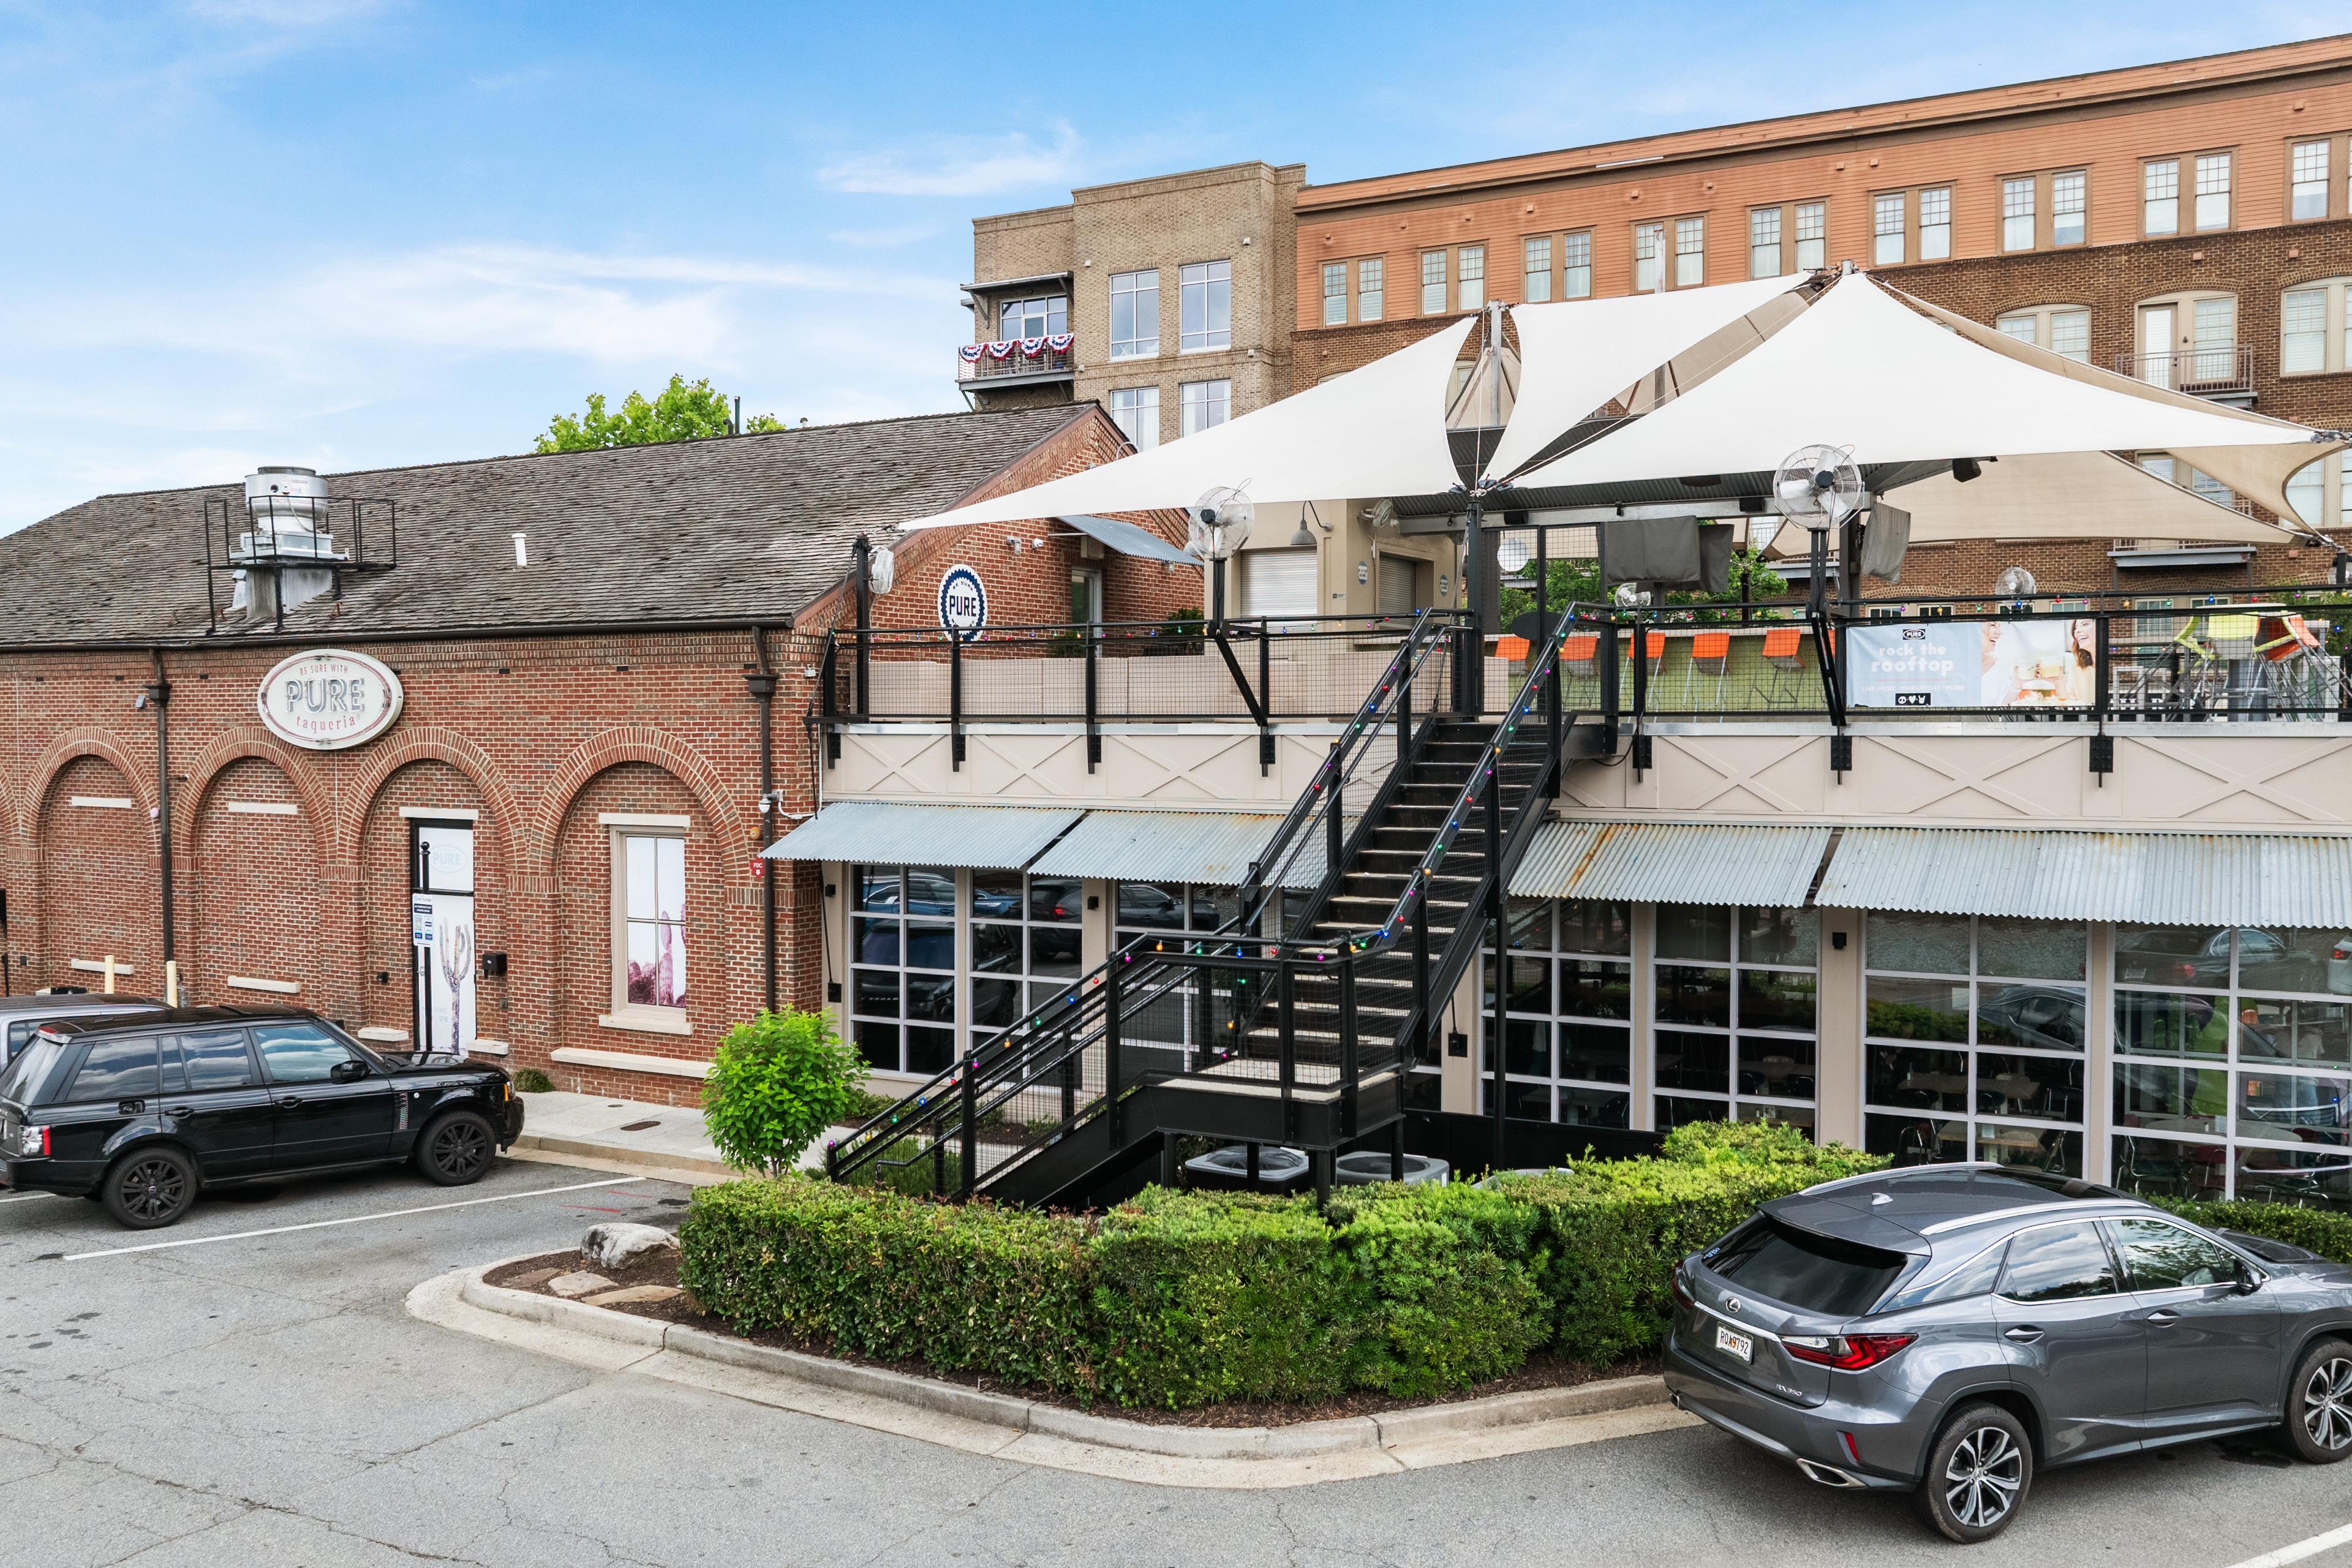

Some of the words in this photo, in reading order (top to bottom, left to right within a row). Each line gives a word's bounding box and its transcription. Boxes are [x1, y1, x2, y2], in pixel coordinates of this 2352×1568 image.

[949, 595, 976, 617] PURE
[1879, 643, 1913, 657] rock
[1920, 643, 1947, 655] the
[300, 666, 307, 676] BE
[311, 664, 327, 674] SURE
[331, 664, 348, 674] WITH
[1871, 656, 1954, 677] rooftop
[284, 677, 364, 714] PURE
[432, 852, 461, 865] PURE
[1720, 1330, 1749, 1355] RQA9792
